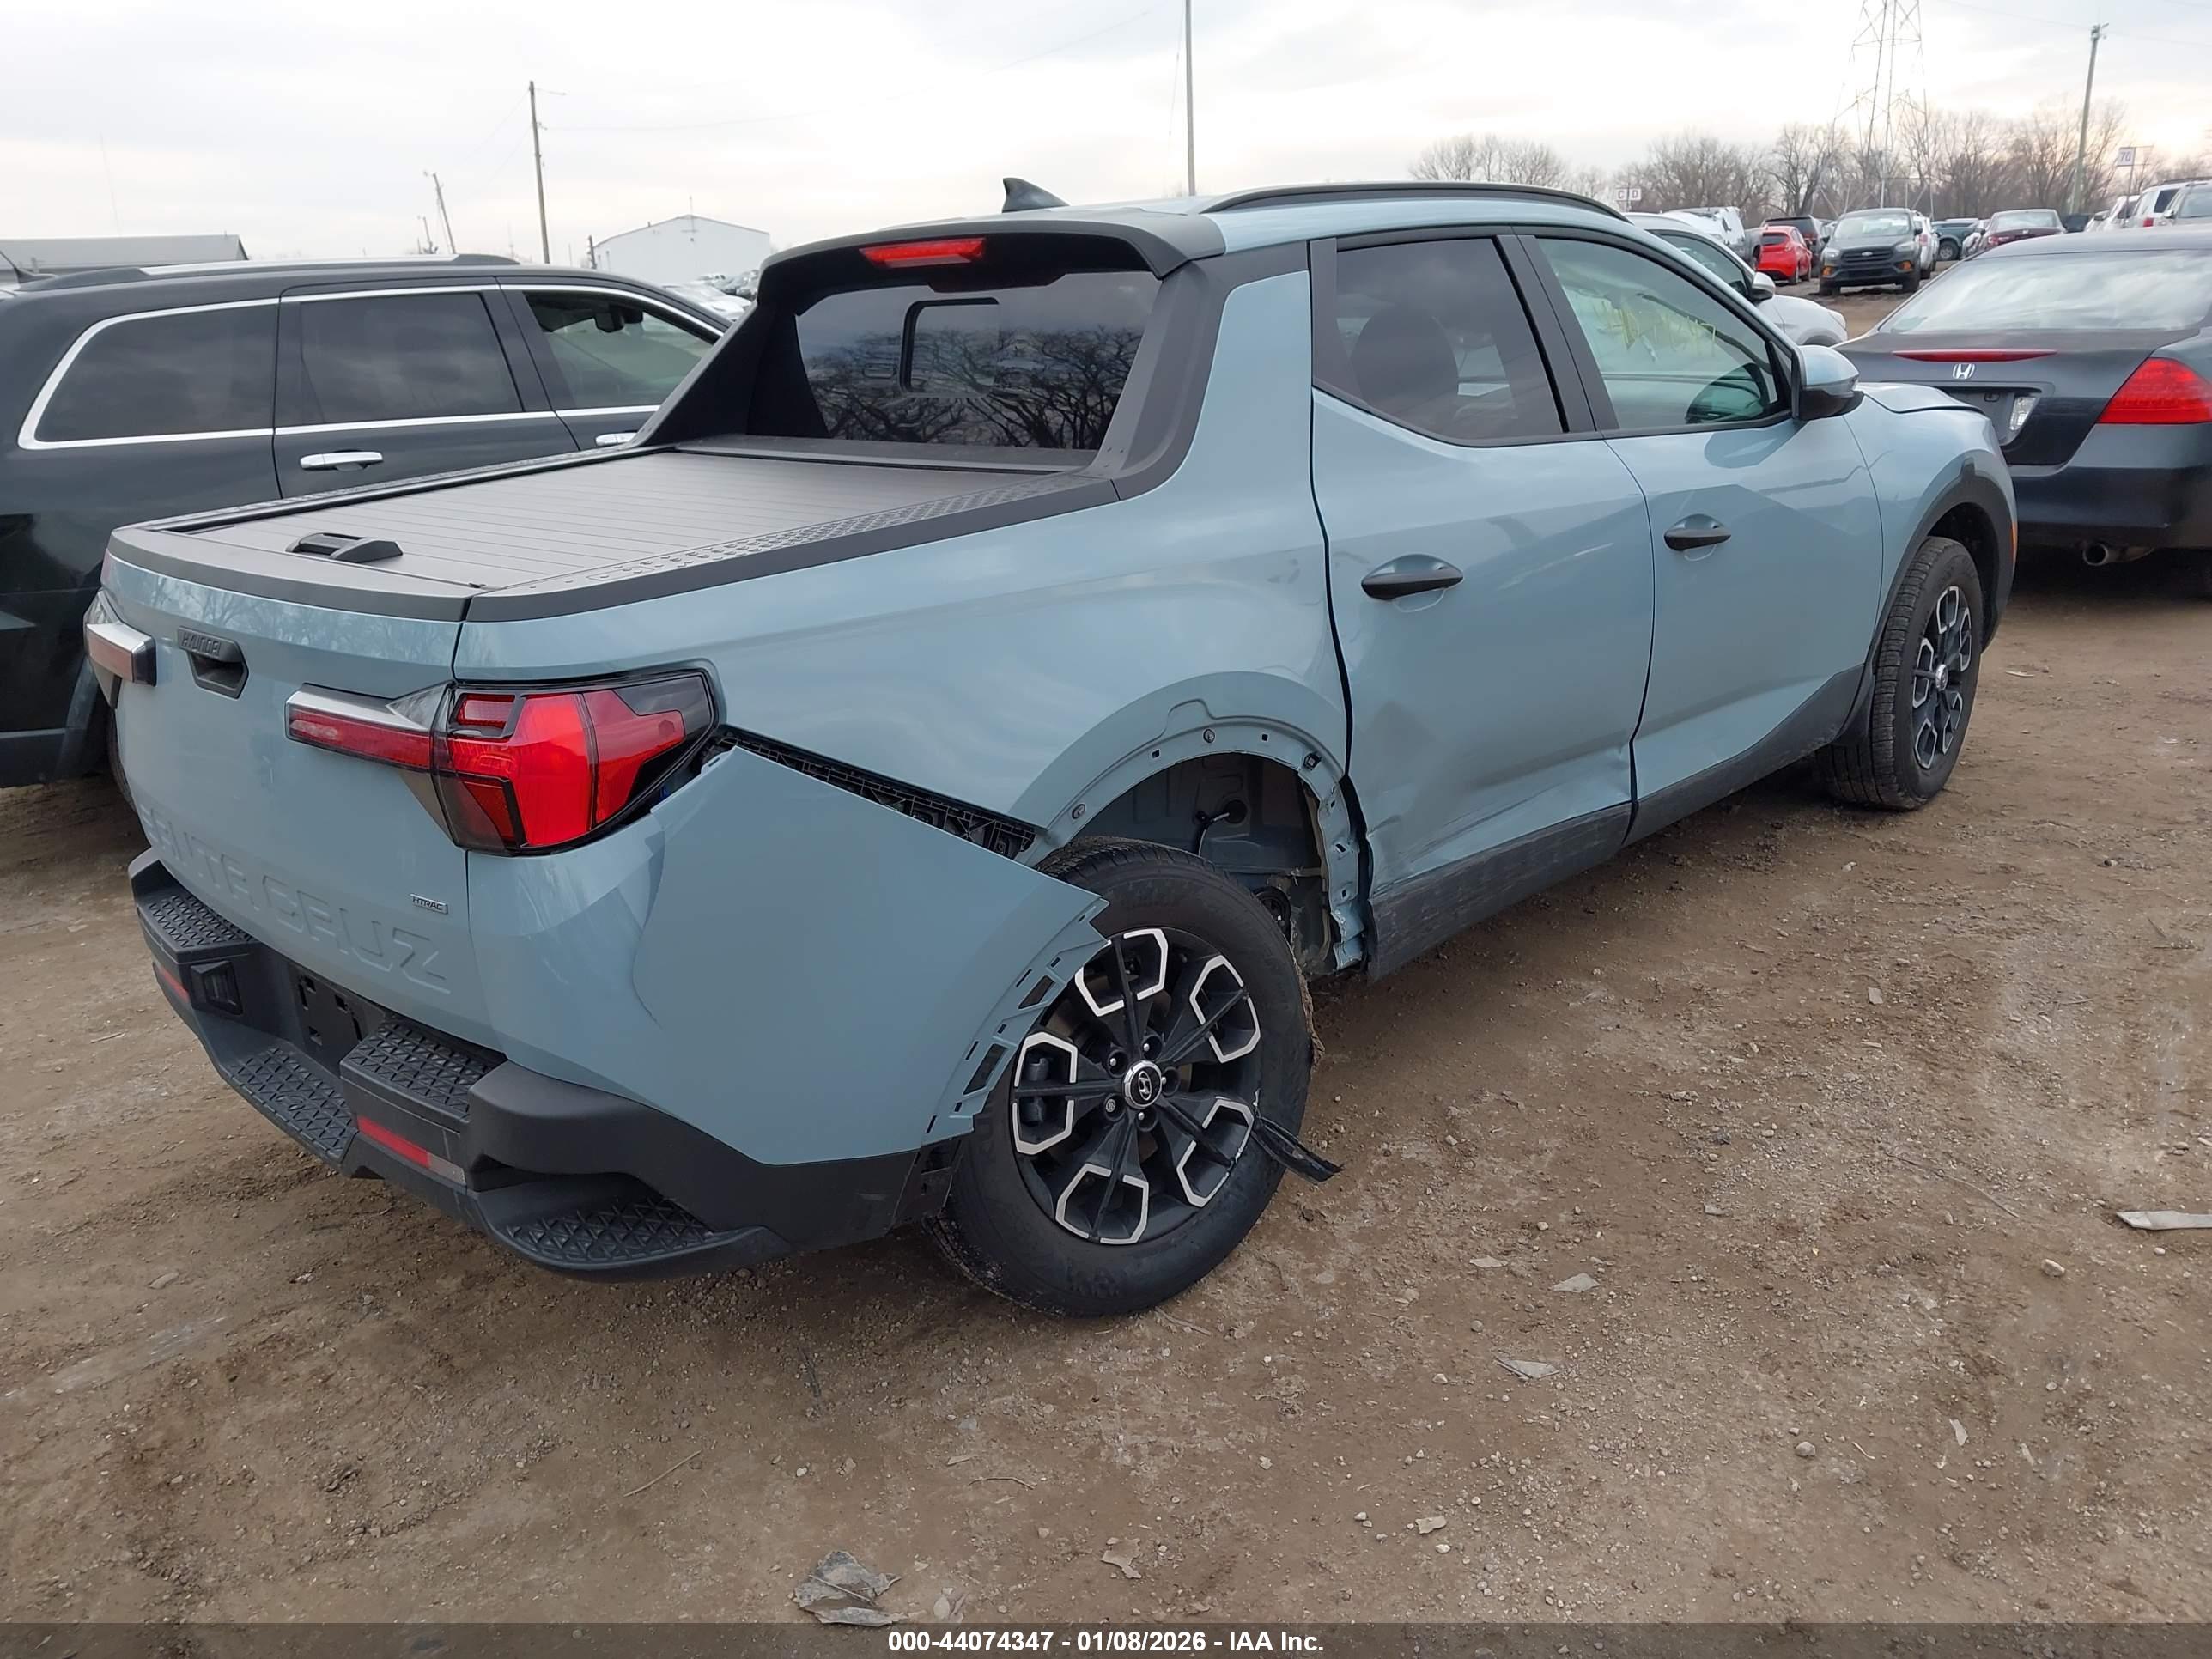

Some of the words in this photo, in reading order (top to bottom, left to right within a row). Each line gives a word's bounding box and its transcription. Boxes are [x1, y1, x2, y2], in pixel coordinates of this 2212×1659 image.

[2120, 151, 2131, 162] 70
[181, 630, 221, 655] HYUNDAI
[139, 803, 260, 912] SANTA
[263, 875, 451, 994] CRUZ
[412, 895, 443, 907] HTRAC
